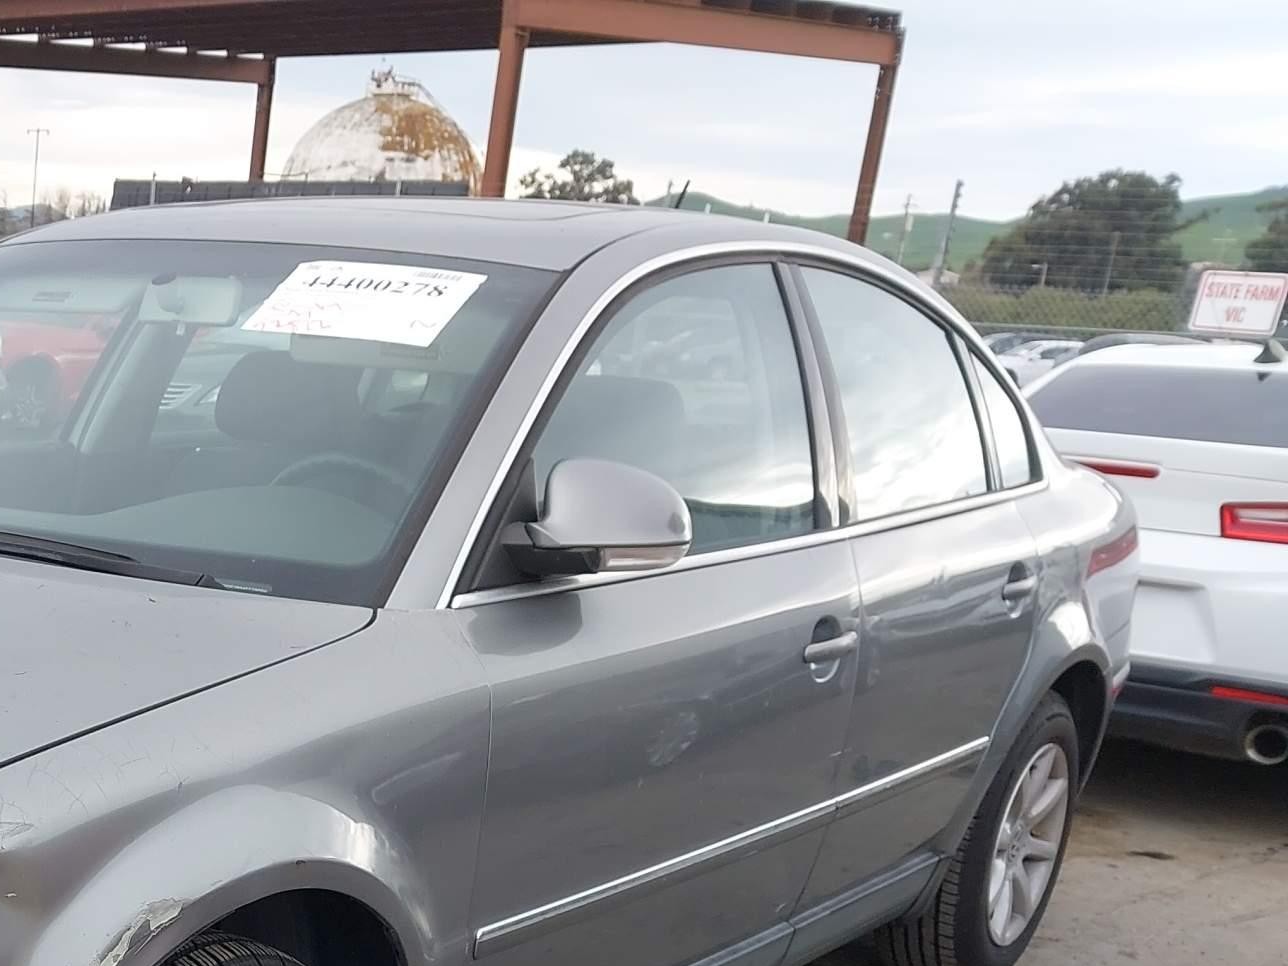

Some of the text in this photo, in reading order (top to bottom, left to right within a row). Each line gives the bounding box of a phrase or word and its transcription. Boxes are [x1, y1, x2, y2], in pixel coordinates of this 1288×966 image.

[303, 275, 448, 297] 44400278
[1205, 281, 1281, 301] STATE FARM
[1223, 306, 1247, 322] VIC
